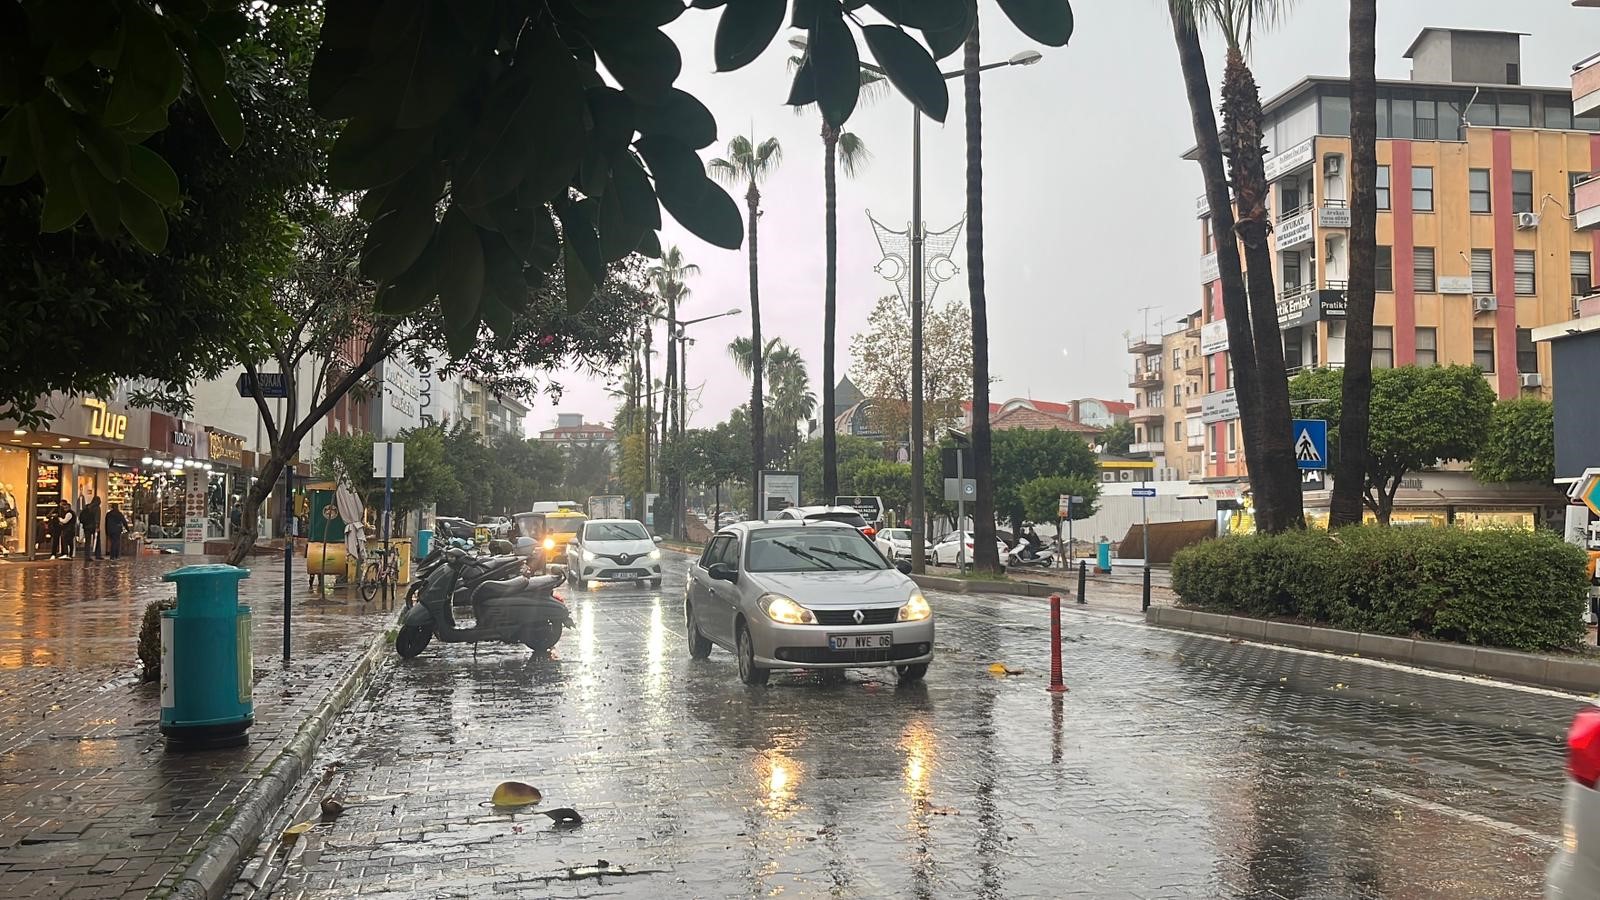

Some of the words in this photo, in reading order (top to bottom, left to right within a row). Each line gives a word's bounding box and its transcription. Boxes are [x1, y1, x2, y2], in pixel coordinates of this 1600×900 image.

[1282, 217, 1305, 232] AVUKAT
[1289, 295, 1311, 313] Emlak
[1321, 301, 1344, 309] Pratik
[82, 397, 127, 440] Due
[174, 431, 194, 447] TUDORS
[836, 637, 848, 648] 07
[855, 636, 872, 647] NVE
[879, 635, 890, 647] 06
